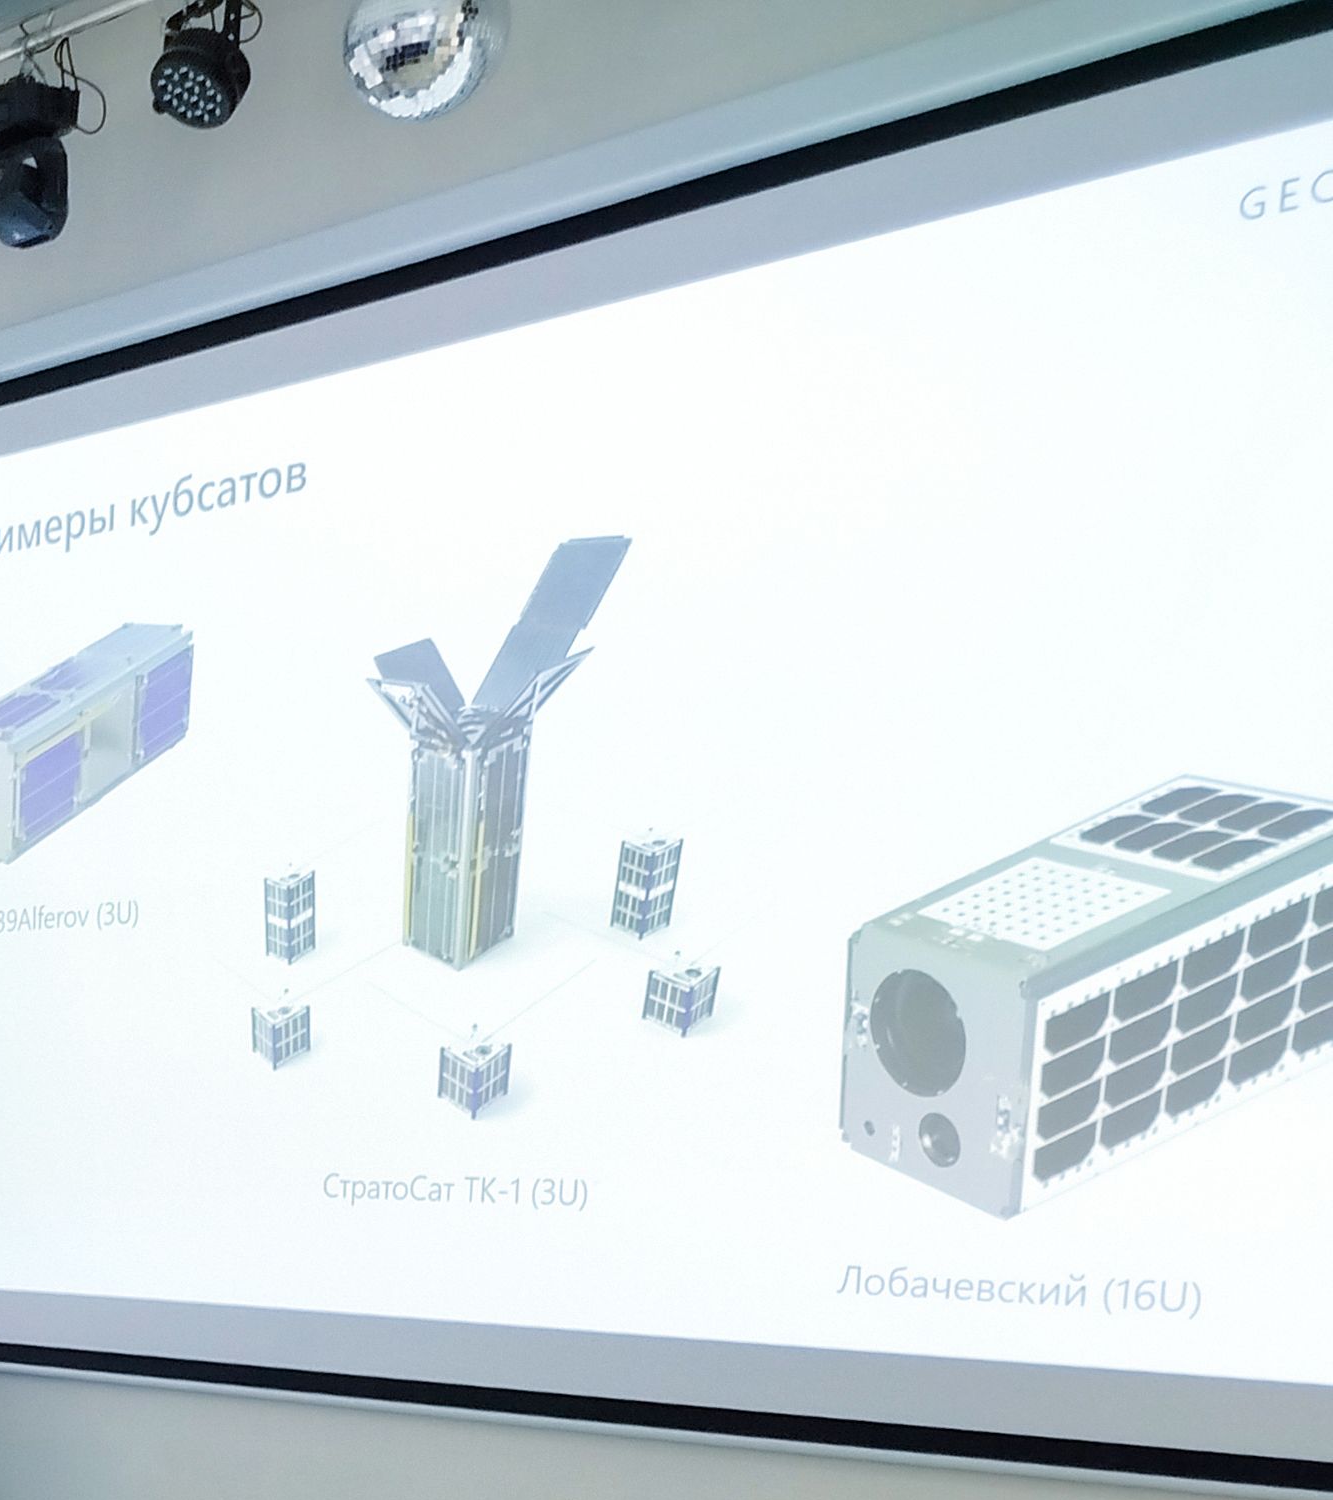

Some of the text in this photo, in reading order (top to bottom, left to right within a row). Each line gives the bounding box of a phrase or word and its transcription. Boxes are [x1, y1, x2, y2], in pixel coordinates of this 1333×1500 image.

[129, 461, 309, 537] кубсатов
[96, 899, 140, 931] (3U)
[322, 1172, 589, 1212] СтратоСат ТК-1 (3U)
[836, 1264, 1203, 1320] Лобачевский (16U)
